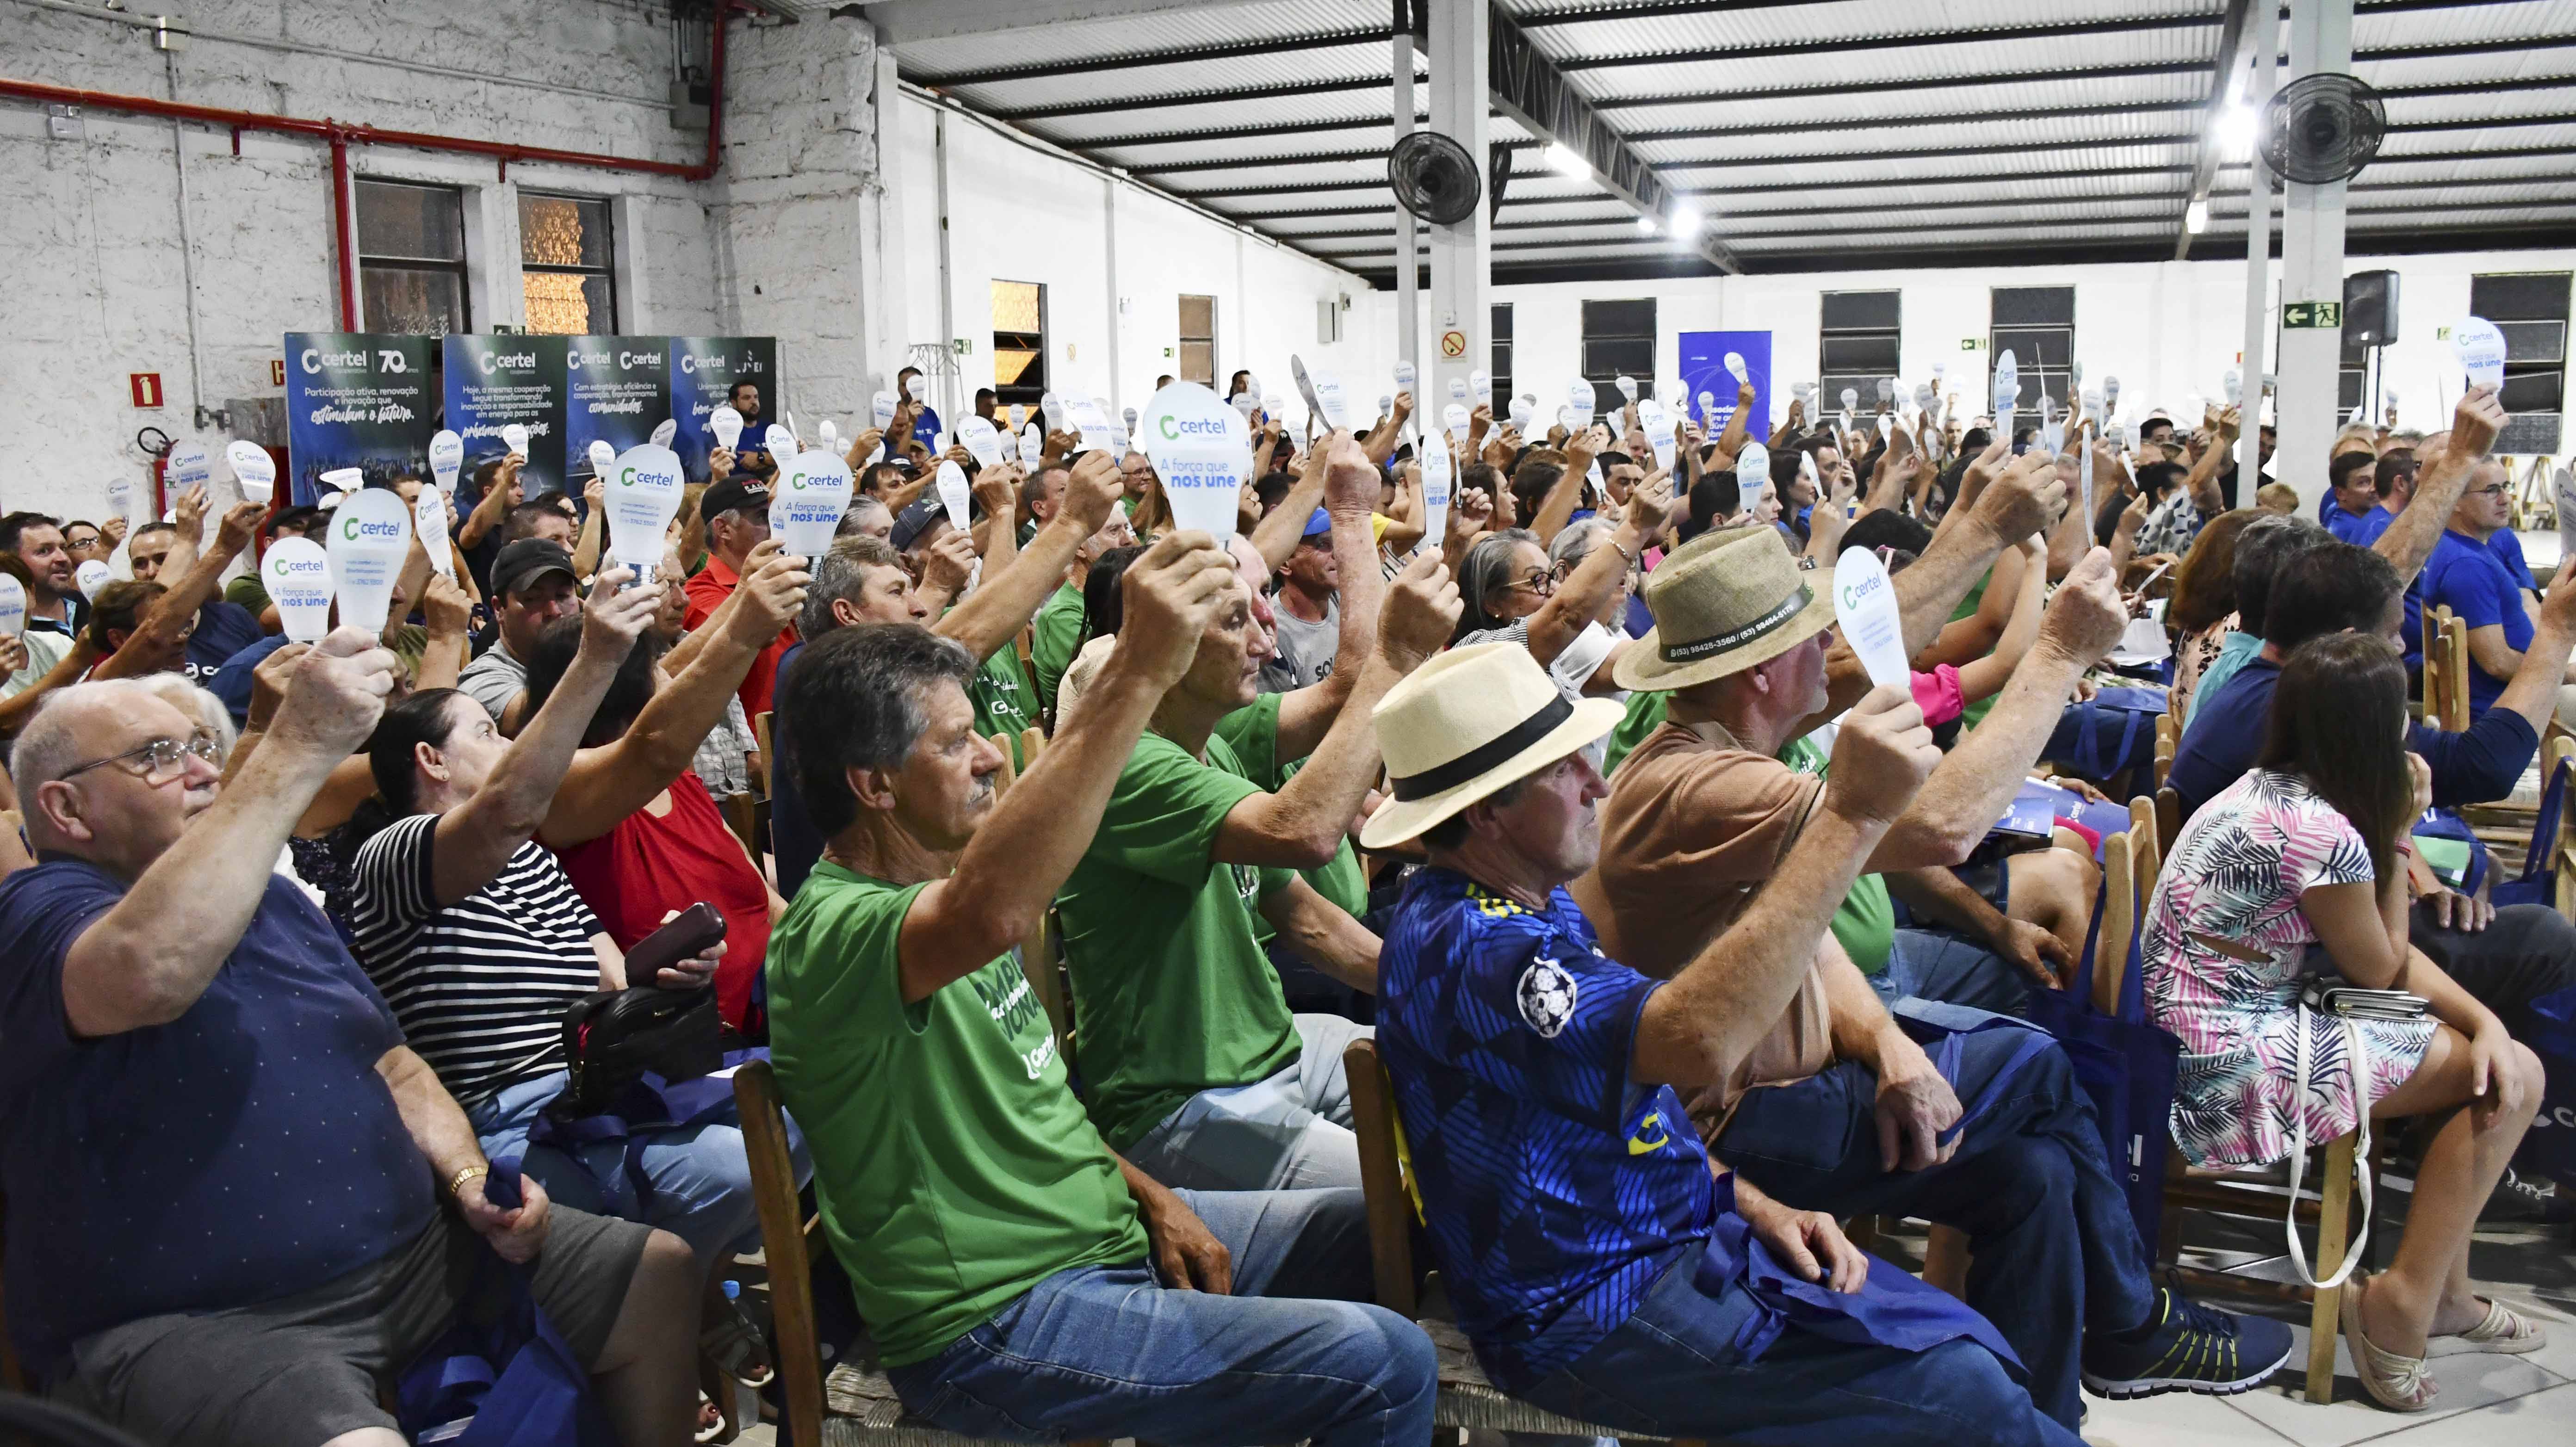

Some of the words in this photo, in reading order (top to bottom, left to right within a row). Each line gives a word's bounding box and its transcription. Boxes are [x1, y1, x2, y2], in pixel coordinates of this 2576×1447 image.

[2469, 332, 2494, 342] certel
[322, 350, 366, 367] certel
[378, 350, 407, 373] 70
[496, 352, 535, 368] certel
[580, 351, 611, 364] certel
[632, 352, 661, 365] certel
[694, 355, 724, 368] certel
[2485, 359, 2502, 367] une
[463, 386, 481, 396] Hoje,
[514, 385, 551, 396] cooperação
[574, 383, 589, 391] Com
[623, 382, 651, 391] eficiência
[305, 388, 355, 398] Participação
[357, 388, 378, 396] ativa,
[380, 387, 418, 397] renovação
[341, 396, 376, 406] inovação
[472, 396, 492, 404] segue
[461, 402, 492, 412] inovação
[498, 400, 553, 411] responsabilidade
[588, 398, 644, 414] comunidades.
[311, 404, 366, 425] estimulam
[369, 409, 377, 421] o
[489, 410, 513, 420] energia
[514, 410, 530, 419] para
[1180, 419, 1226, 435] certel
[442, 443, 458, 452] certel
[184, 454, 204, 464] certel
[245, 454, 266, 463] certel
[1161, 458, 1170, 471] A
[1173, 458, 1203, 476] força
[1207, 461, 1228, 476] que
[637, 472, 674, 486] certel
[808, 475, 842, 486] certel
[1171, 475, 1201, 488] nos
[1206, 474, 1236, 488] une
[1428, 497, 1437, 505] nos
[1438, 495, 1447, 505] une
[786, 502, 792, 511] A
[794, 502, 816, 514] força
[819, 504, 835, 514] que
[790, 513, 812, 522] nos
[816, 513, 838, 522] une
[361, 521, 400, 536] certel
[290, 561, 323, 571] certel
[91, 570, 108, 580] certel
[1855, 573, 1882, 598] certel
[283, 587, 304, 599] força
[306, 589, 322, 599] que
[282, 598, 303, 607] nos
[306, 598, 328, 607] une
[1677, 647, 1689, 657] (53)
[1690, 634, 1736, 654] 98428-3560
[1740, 627, 1756, 640] (53)
